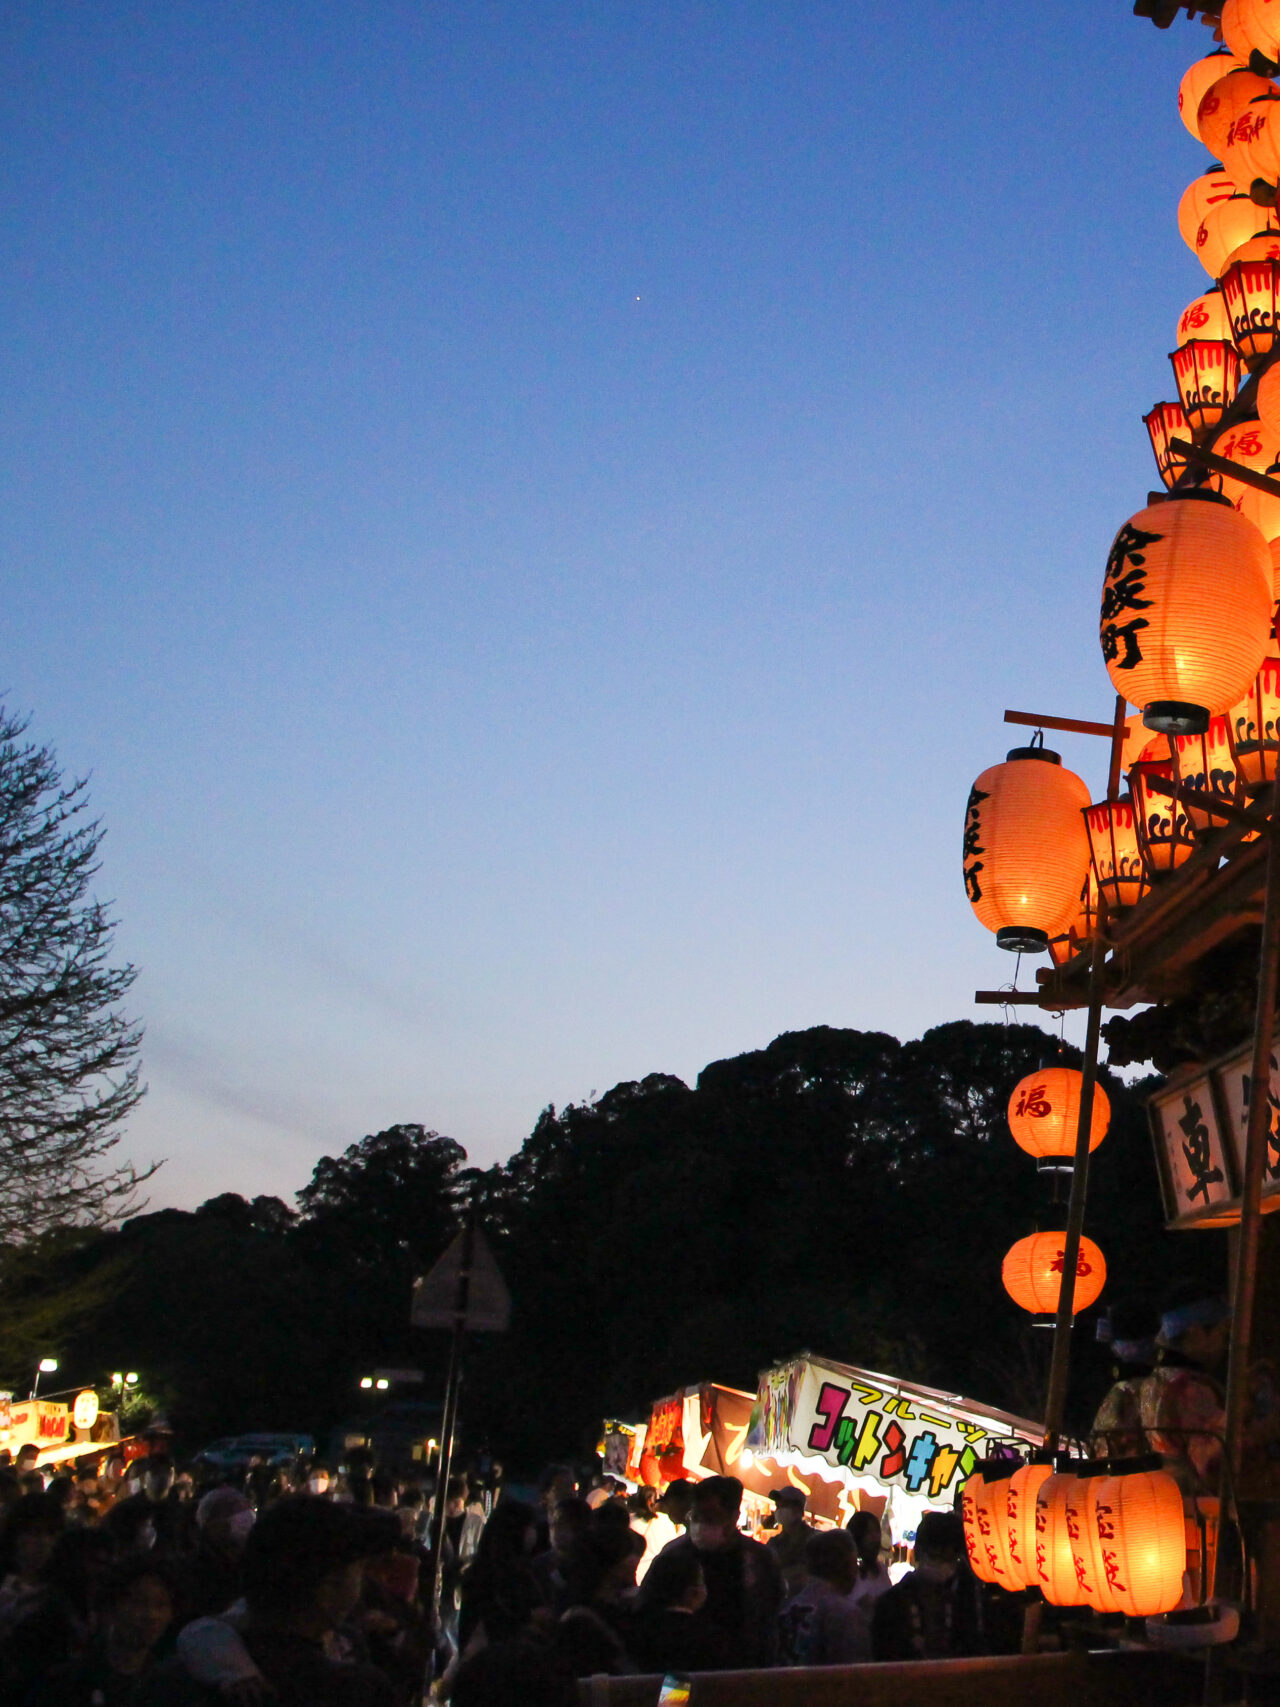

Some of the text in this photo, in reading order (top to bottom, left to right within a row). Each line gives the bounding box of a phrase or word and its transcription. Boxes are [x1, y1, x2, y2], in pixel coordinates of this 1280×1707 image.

[1015, 1085, 1052, 1118] 福
[850, 1382, 988, 1444] フルーツ
